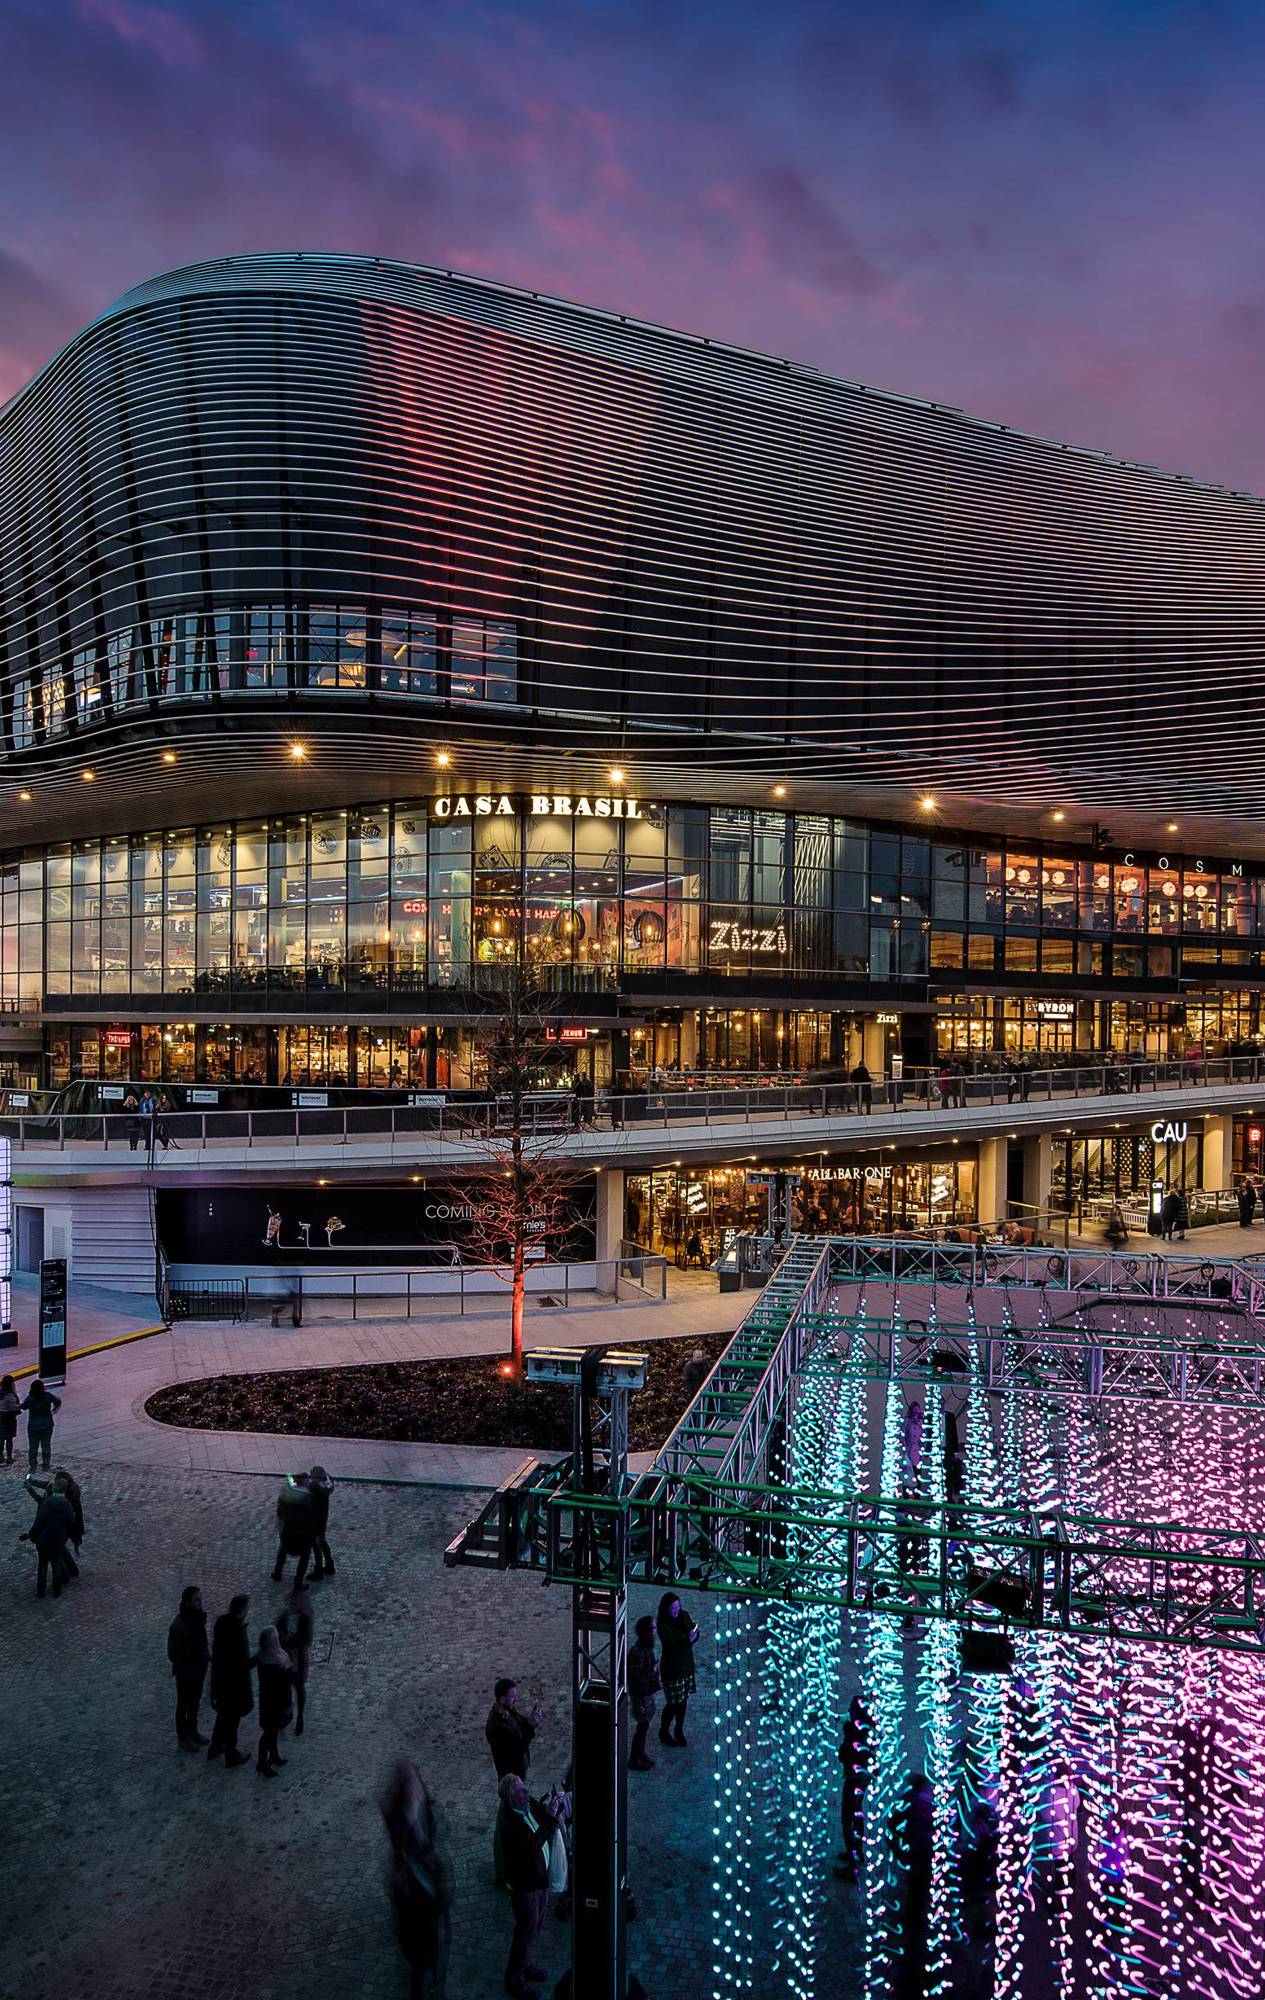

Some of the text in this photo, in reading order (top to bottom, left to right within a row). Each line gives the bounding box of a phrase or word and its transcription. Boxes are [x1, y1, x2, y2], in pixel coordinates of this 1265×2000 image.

[434, 795, 642, 819] CASA BRASIL
[403, 901, 428, 914] COM
[442, 904, 490, 916] HRY
[708, 921, 787, 953] Zizzi
[1037, 1002, 1074, 1013] BYRON
[876, 1013, 898, 1024] Zizzi
[1151, 1122, 1187, 1143] CAU
[425, 1204, 496, 1219] COMING
[520, 1220, 546, 1230] rnie's
